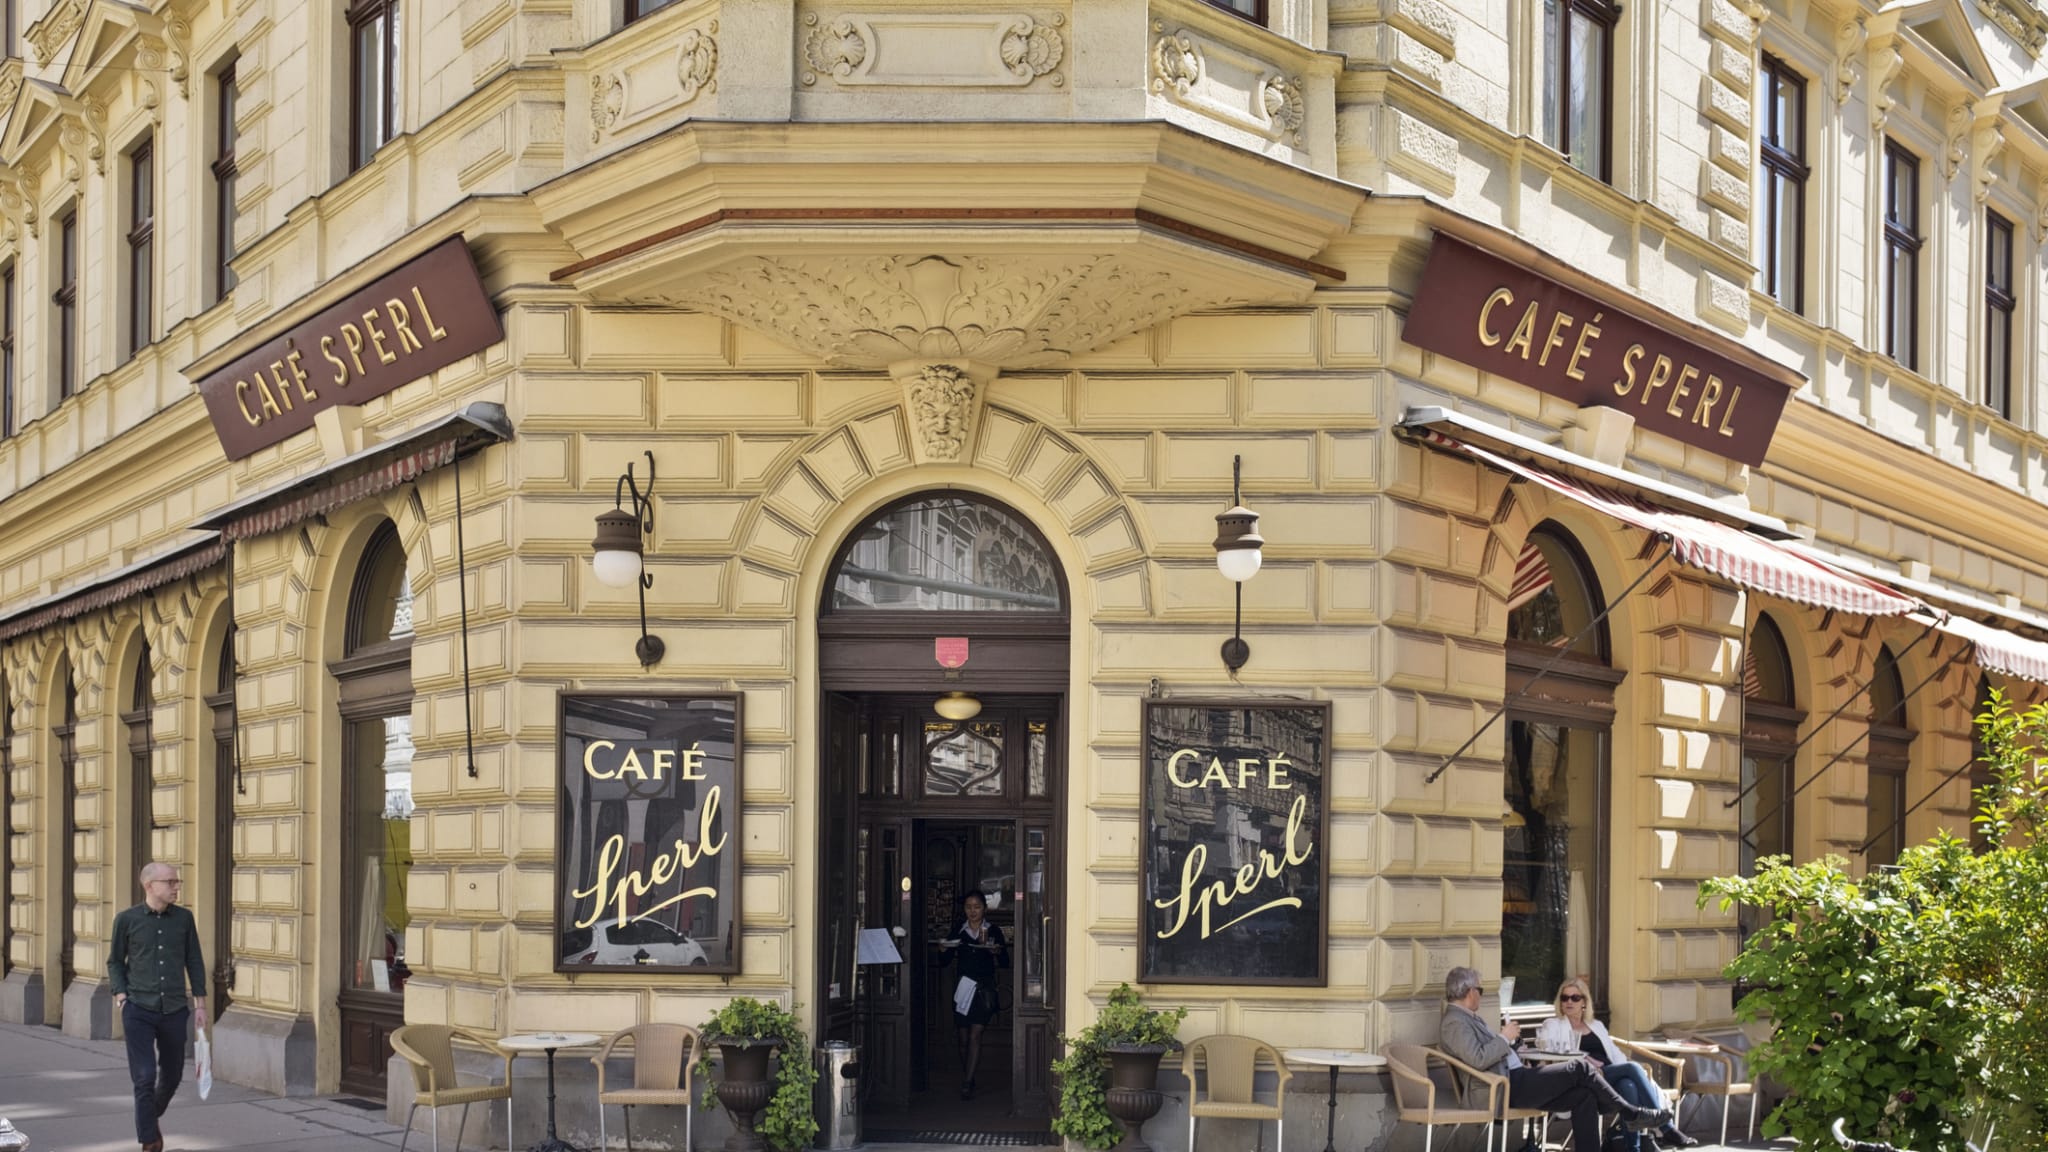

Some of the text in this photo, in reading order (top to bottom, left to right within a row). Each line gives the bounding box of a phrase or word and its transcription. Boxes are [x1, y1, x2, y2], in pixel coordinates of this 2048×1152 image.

[235, 285, 448, 428] CAFÉ SPERL
[1477, 287, 1743, 438] CAFÉ SPERL
[583, 740, 707, 780] CAFÉ
[1167, 749, 1292, 790] CAFÉ
[572, 785, 728, 929] Sperl
[1155, 794, 1313, 940] Sperl
